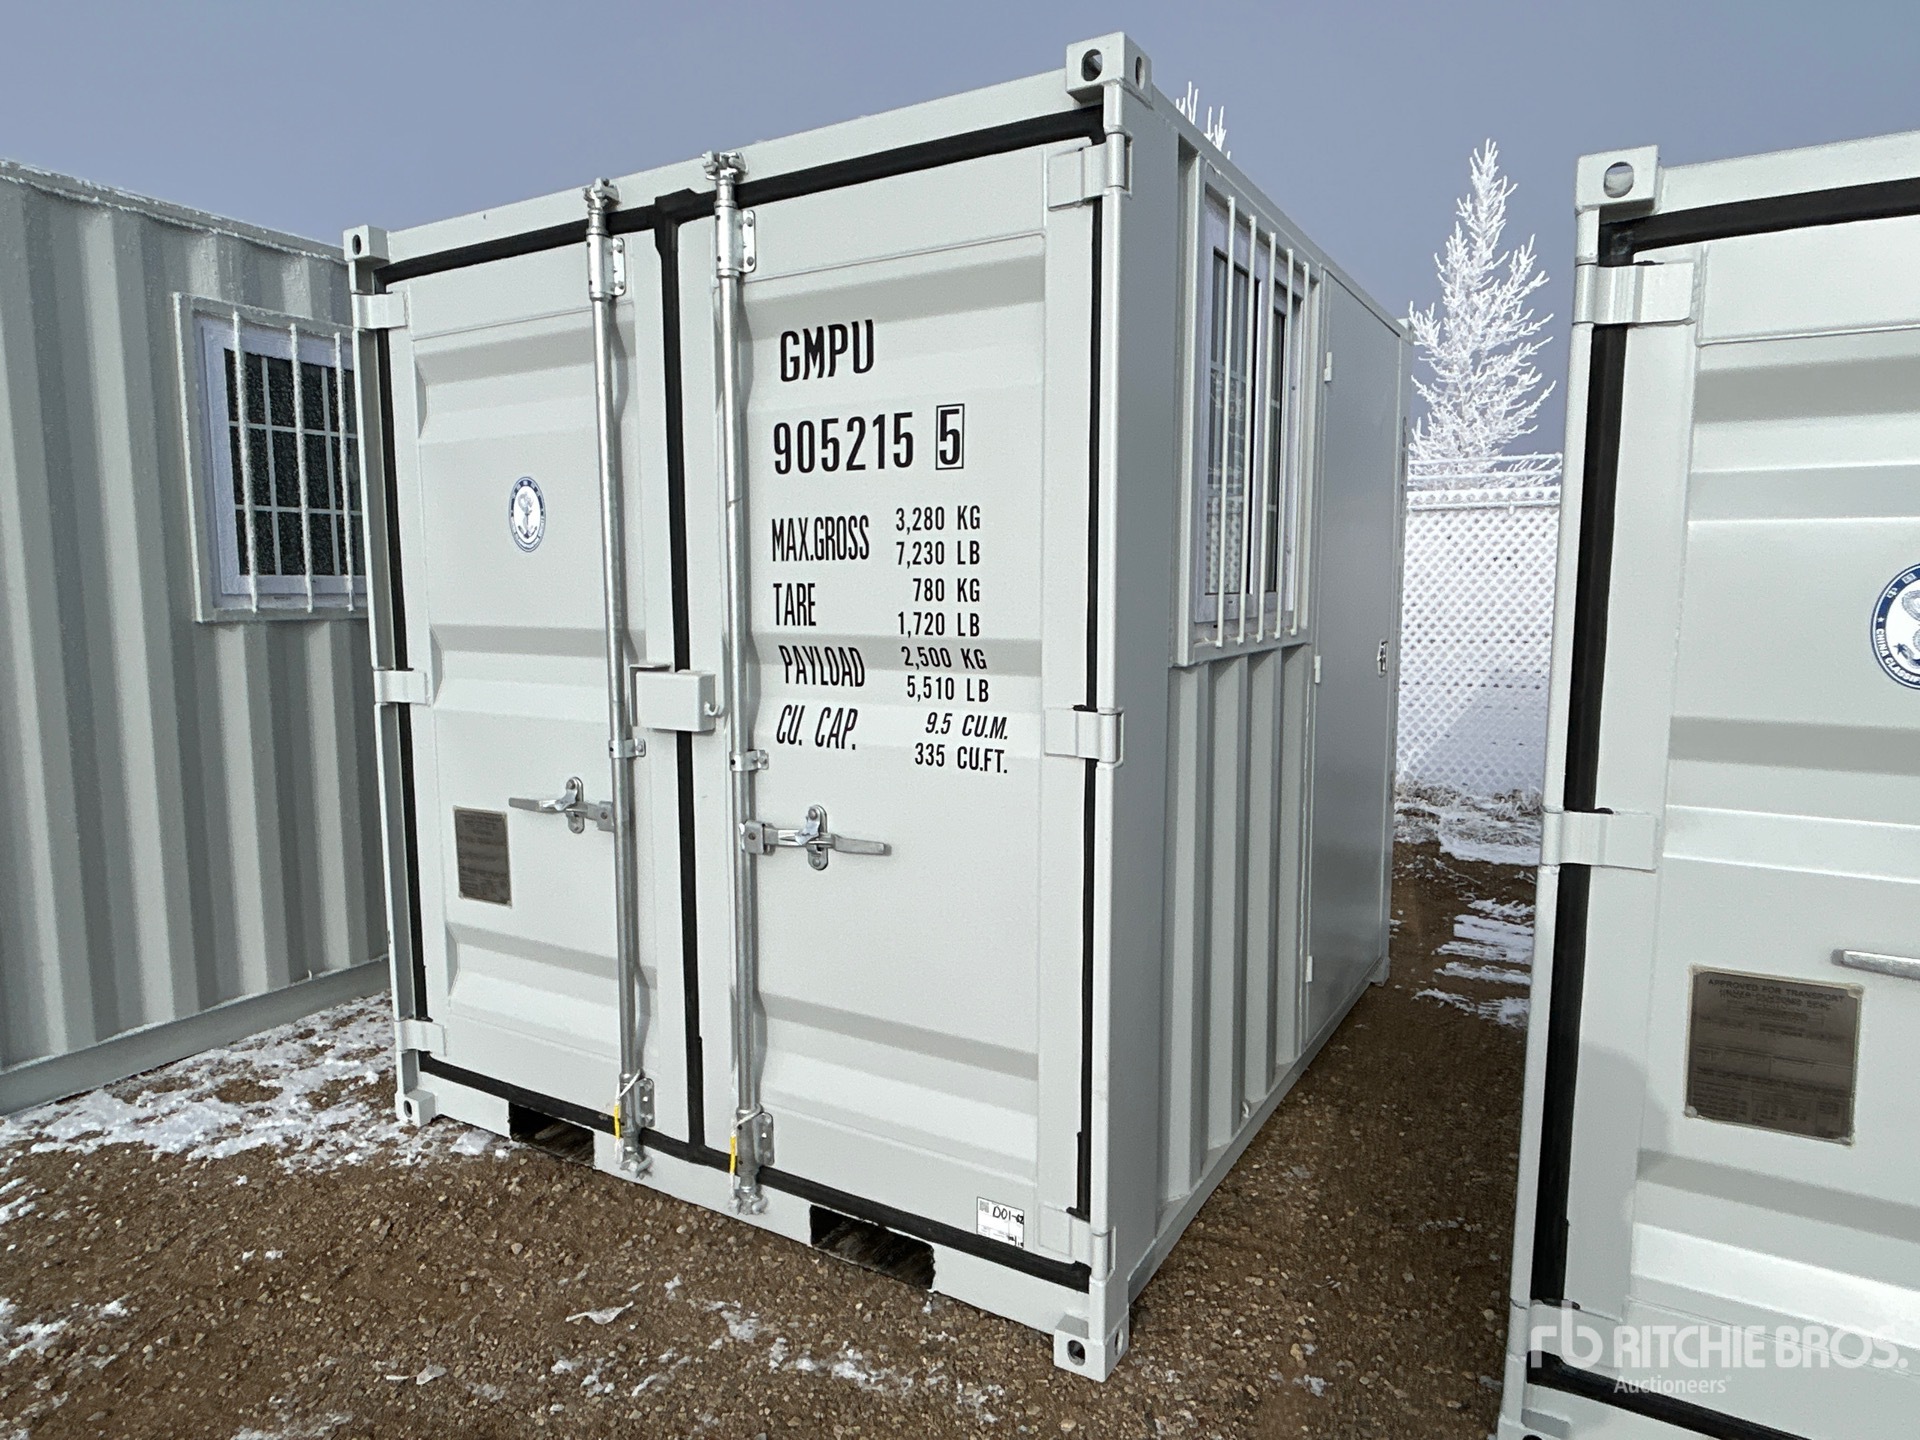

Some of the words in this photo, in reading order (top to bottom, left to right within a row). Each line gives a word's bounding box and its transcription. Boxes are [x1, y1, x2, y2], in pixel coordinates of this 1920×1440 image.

[780, 318, 874, 383] GMPU
[773, 411, 914, 475] 905215
[939, 408, 961, 465] 5
[771, 514, 870, 562] MAX.GROSS
[895, 506, 945, 535] 3,280
[957, 505, 981, 531] KG
[896, 540, 945, 569] 7,230
[957, 540, 980, 565] LB
[772, 582, 817, 627] TARE
[912, 577, 945, 602] 780
[957, 577, 980, 603] KG
[898, 611, 945, 639] 1,720
[957, 612, 980, 637] LB
[1876, 628, 1890, 657] CHINA
[778, 644, 865, 688] PAYLOAD
[900, 645, 952, 670] 2,500
[960, 647, 988, 670] KG
[907, 674, 955, 702] 5,510
[966, 678, 989, 703] LB
[776, 704, 806, 746] CU.
[814, 706, 858, 751] CAP.
[925, 711, 953, 735] 9.5
[961, 714, 1008, 740] CU.M.
[914, 742, 946, 768] 335
[957, 746, 1008, 774] CU.FT.
[1708, 979, 1758, 992] APPROVED
[1762, 986, 1782, 995] FOR
[1786, 989, 1845, 1001] TRANSPORT
